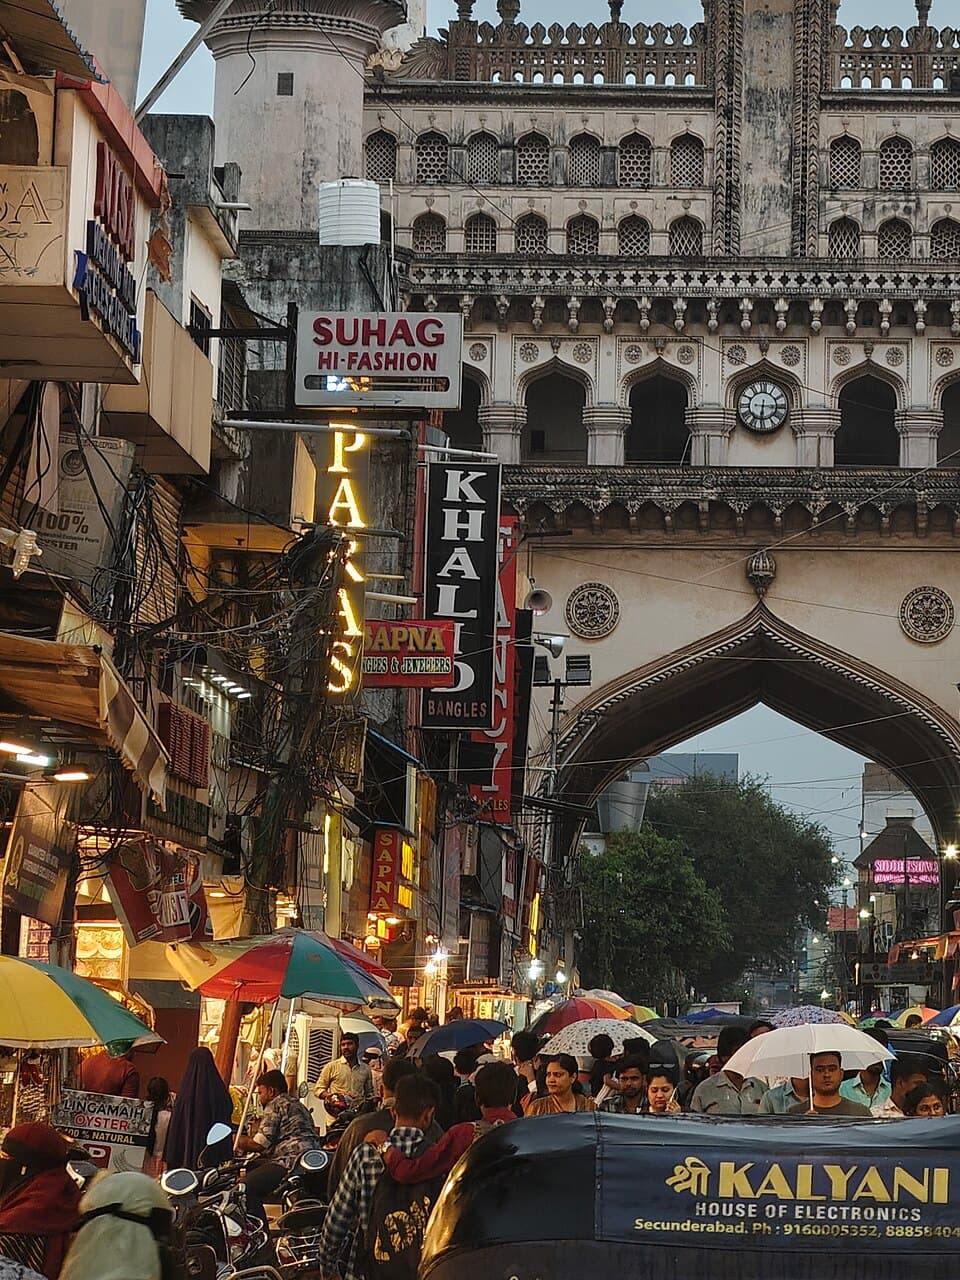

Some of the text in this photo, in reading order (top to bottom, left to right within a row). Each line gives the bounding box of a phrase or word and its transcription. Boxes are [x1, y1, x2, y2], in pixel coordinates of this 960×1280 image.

[312, 317, 446, 348] SUHAG
[318, 351, 438, 372] HI-FASHION
[391, 656, 399, 673] &
[401, 657, 451, 674] JEWELLERS
[428, 699, 488, 719] BANGLES
[374, 833, 393, 910] SAPNA
[73, 1111, 129, 1132] OYSTER
[91, 1130, 135, 1144] NATURAL
[718, 1161, 950, 1204] KALYANI
[695, 1202, 922, 1222] HOUSE OF ELECTRONICS
[634, 1218, 749, 1234] Secunderabad.
